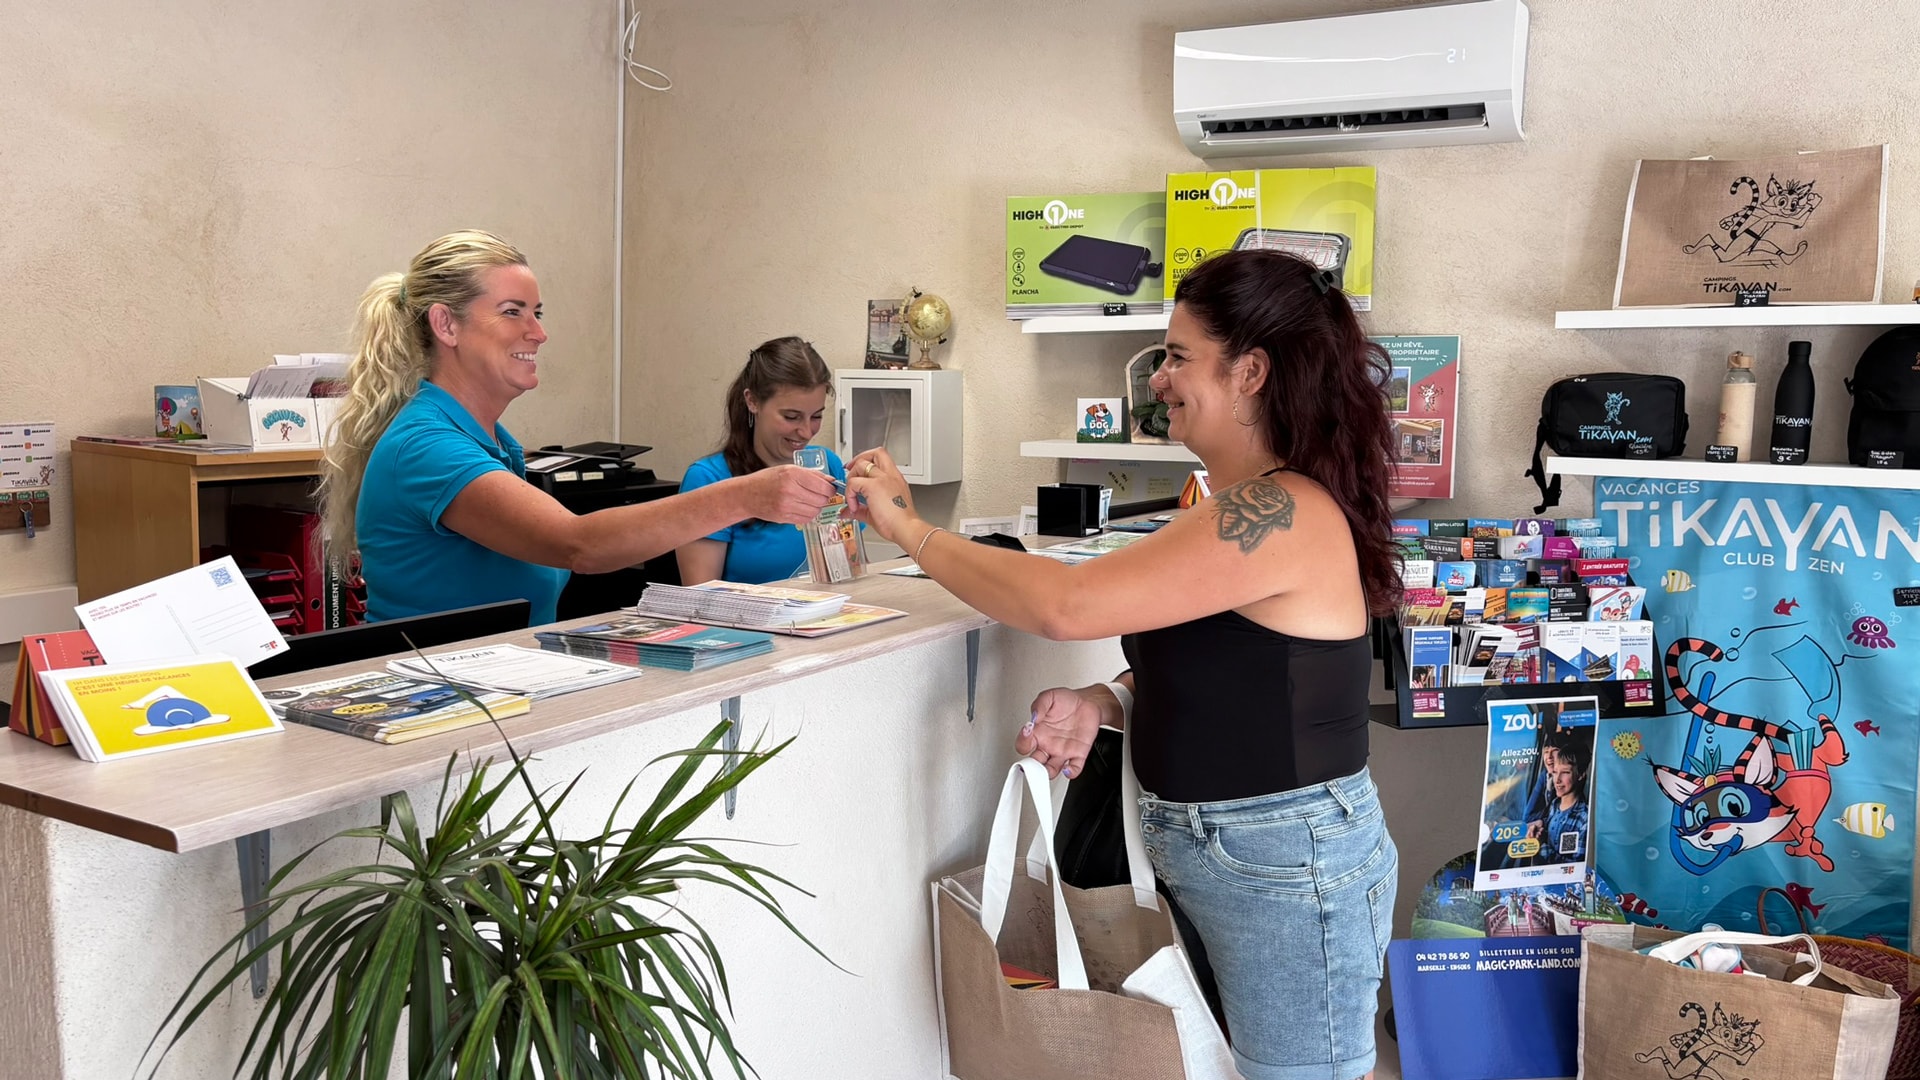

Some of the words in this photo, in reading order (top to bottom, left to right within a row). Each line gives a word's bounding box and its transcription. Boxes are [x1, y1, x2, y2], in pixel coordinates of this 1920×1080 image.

[1174, 189, 1210, 201] HIGH
[1012, 209, 1044, 221] HIGH
[1012, 288, 1040, 296] PLANCHA
[1388, 348, 1440, 356] PROPRIÉTAIRE
[1090, 421, 1109, 429] DOG
[1600, 480, 1701, 496] VACANCES
[1585, 562, 1603, 570] ENTRÉE
[1723, 552, 1776, 568] CLUB
[1807, 556, 1846, 576] ZEN
[331, 583, 340, 629] DOCUMENT
[153, 672, 191, 681] VACANCES
[91, 687, 117, 695] MOINS
[1501, 749, 1522, 757] Allez
[1521, 747, 1540, 756] ZOU,
[1495, 825, 1520, 841] 20€
[1511, 841, 1528, 854] 5€
[1415, 953, 1426, 961] 04
[1426, 952, 1438, 961] 42
[1438, 952, 1447, 960] 79
[1459, 951, 1470, 960] 90
[1479, 949, 1524, 957] BILLETTERIE
[1537, 947, 1558, 955] LIGNE
[1561, 947, 1575, 955] SUR
[1417, 964, 1446, 972] MARSEILLE
